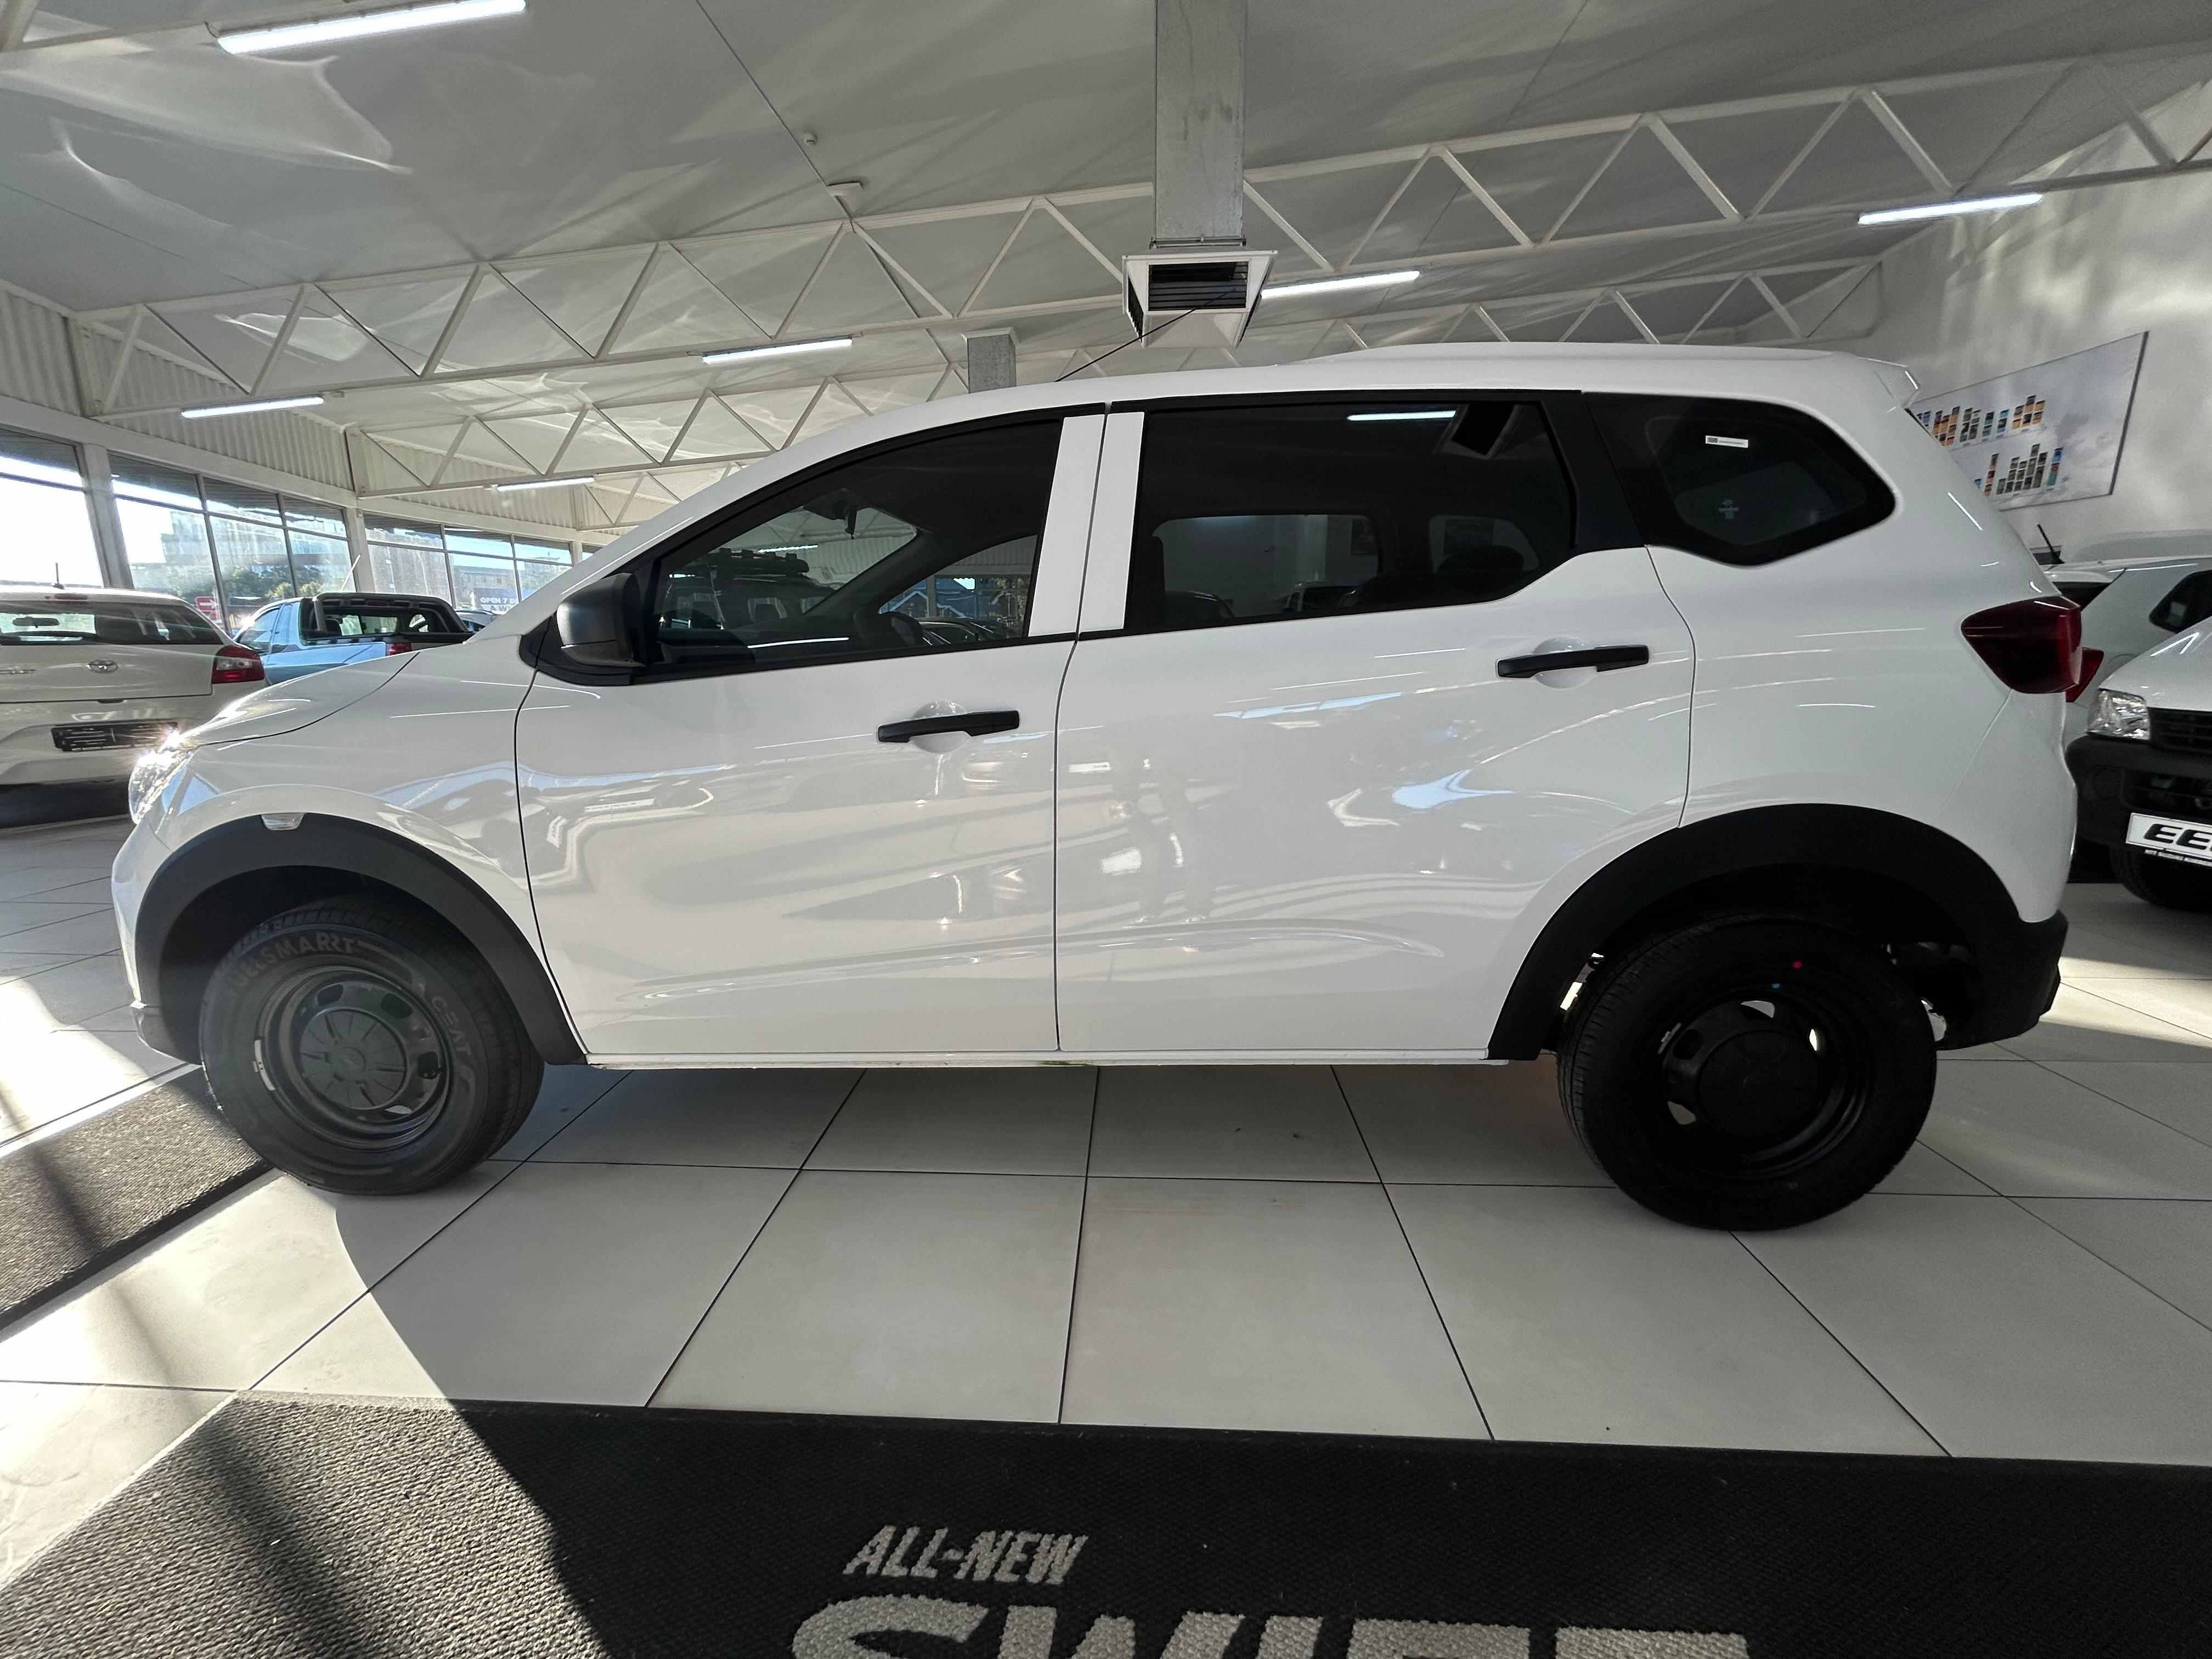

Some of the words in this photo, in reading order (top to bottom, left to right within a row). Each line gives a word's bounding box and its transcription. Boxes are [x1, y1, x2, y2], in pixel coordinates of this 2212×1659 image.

[2143, 823, 2212, 851] EE
[431, 995, 472, 1057] CEAT
[842, 1524, 1089, 1585] ALL-NEW
